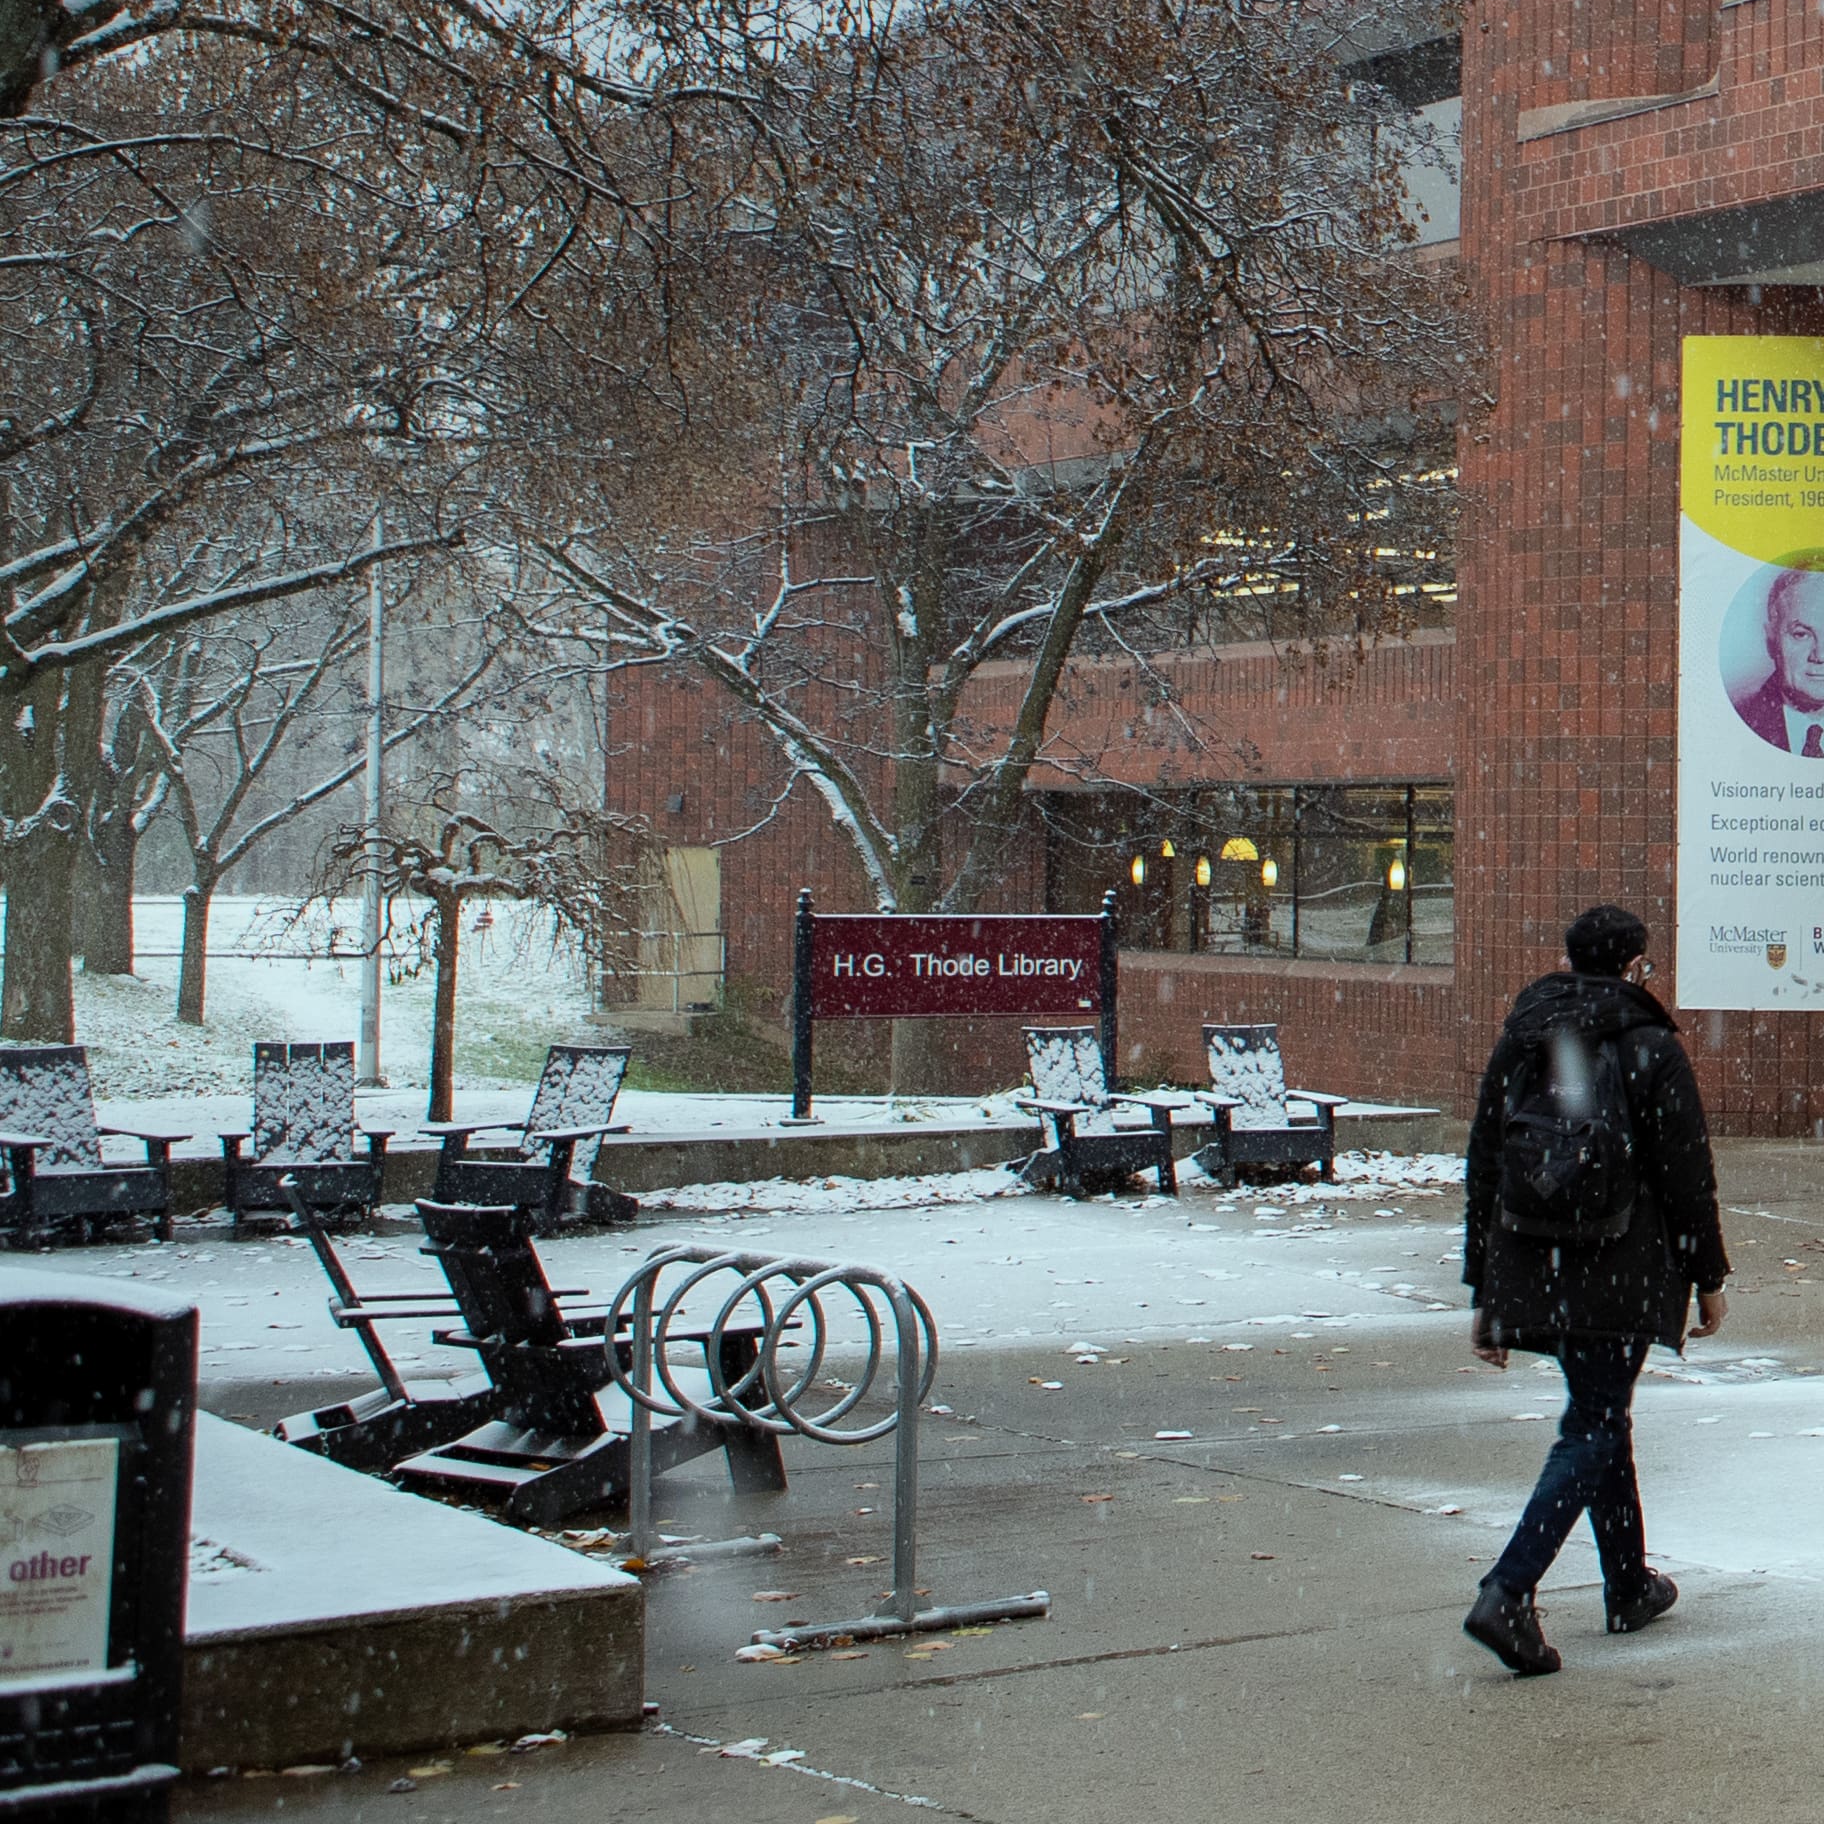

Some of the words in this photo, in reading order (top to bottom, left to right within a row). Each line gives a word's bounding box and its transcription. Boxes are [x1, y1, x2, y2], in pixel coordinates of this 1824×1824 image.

[1714, 464, 1800, 483] McMaster
[1714, 489, 1795, 509] President,
[1711, 781, 1786, 802] Visionary
[1711, 814, 1804, 834] Exceptional
[1710, 847, 1758, 864] World
[1710, 870, 1772, 886] nuclear
[1709, 926, 1788, 943] McMaster
[1709, 943, 1765, 956] University
[833, 954, 892, 976] H.G.
[910, 954, 990, 977] Thode
[998, 954, 1082, 981] Library
[9, 1550, 93, 1582] other
